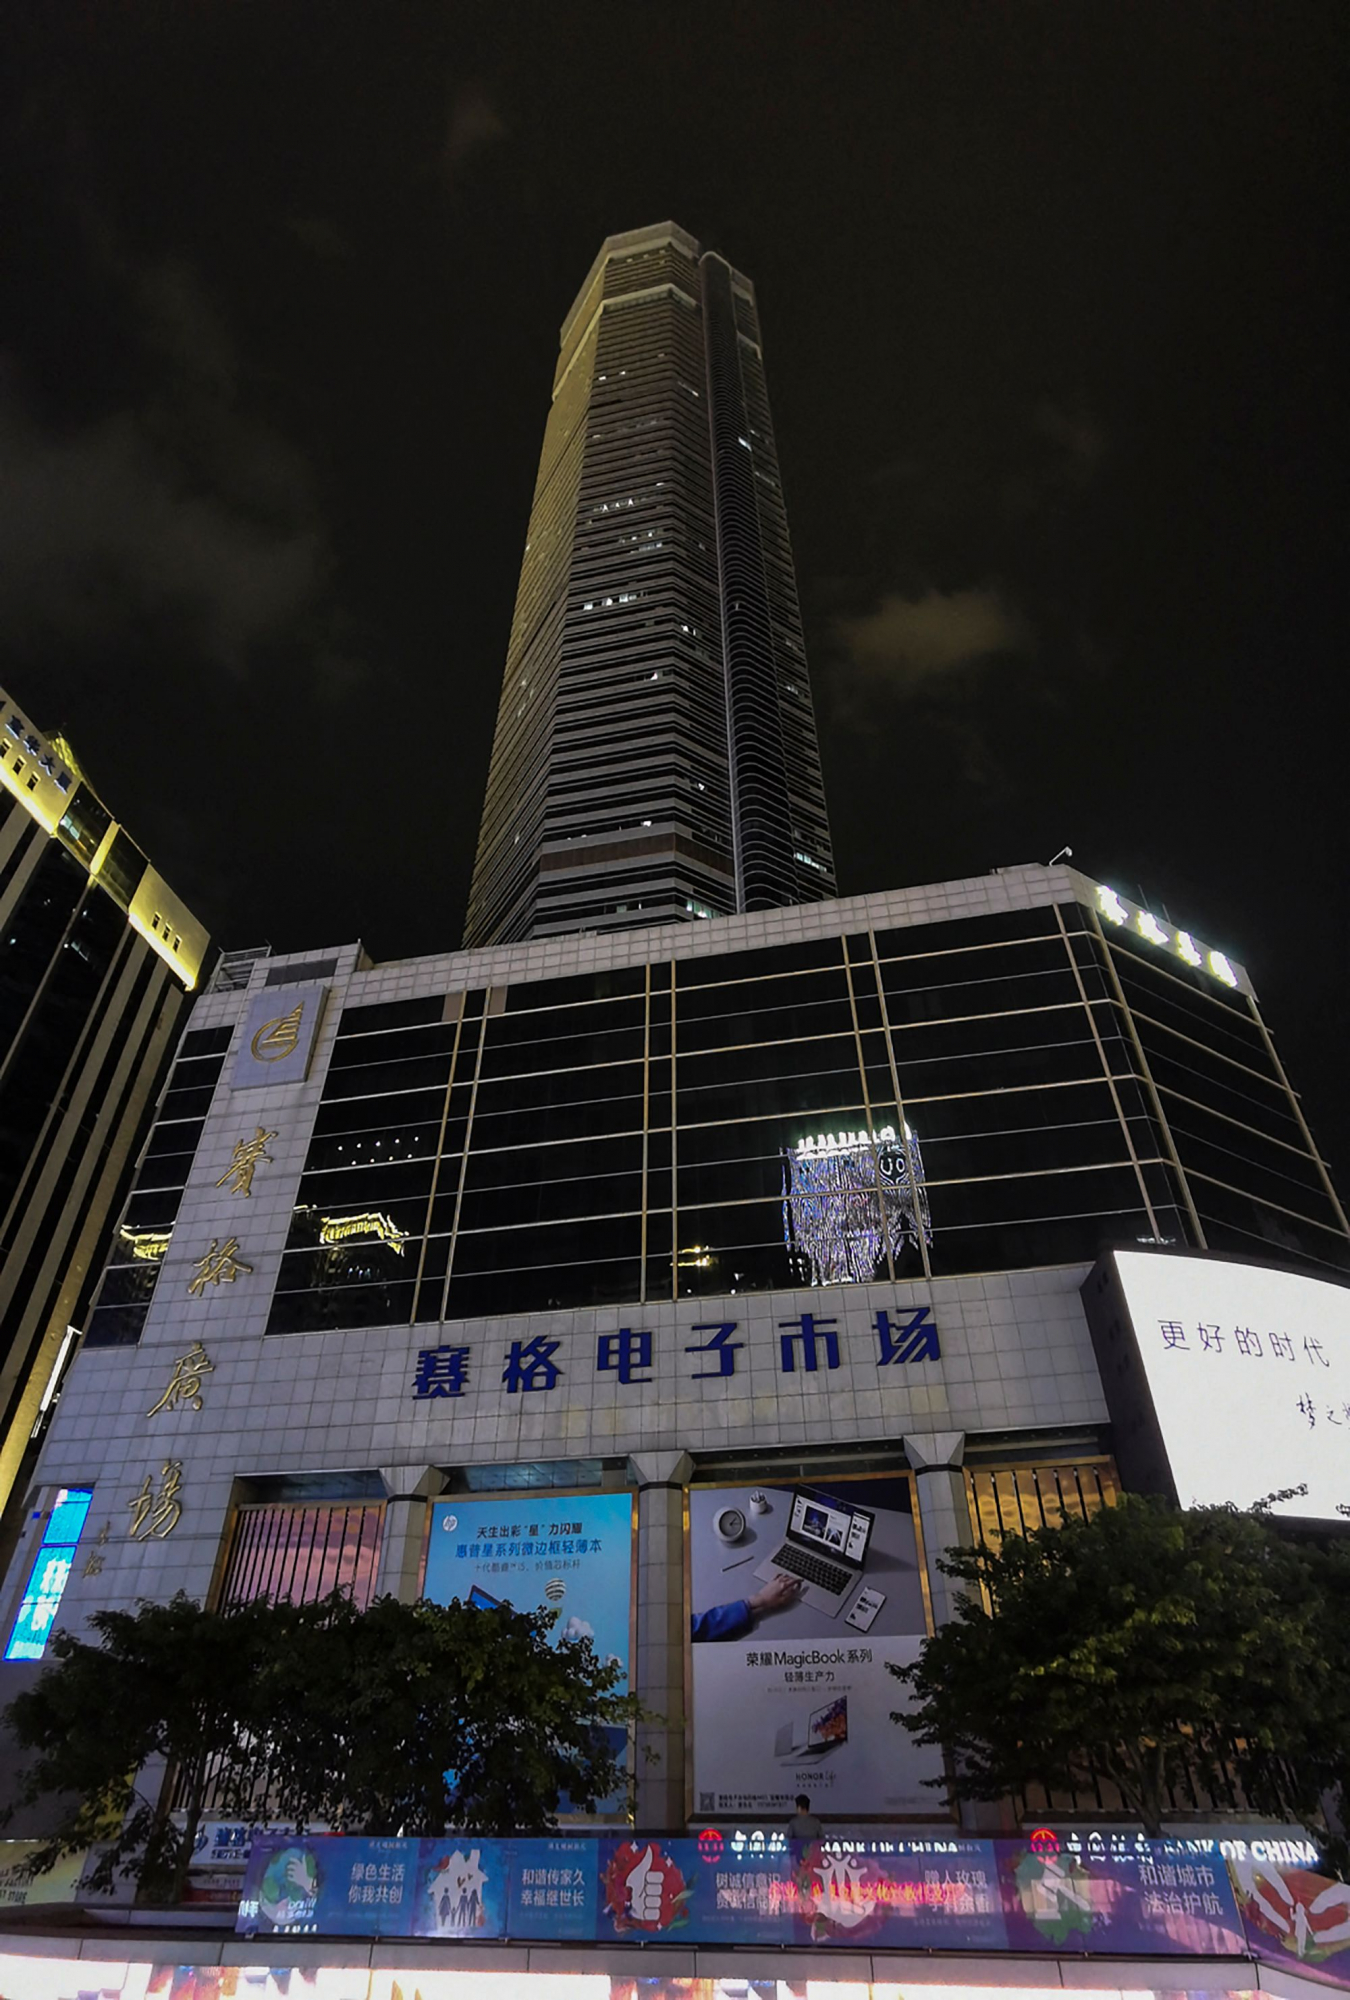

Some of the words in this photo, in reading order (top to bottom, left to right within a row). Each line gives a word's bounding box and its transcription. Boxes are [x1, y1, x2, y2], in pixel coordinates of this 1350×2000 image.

[412, 1306, 942, 1399] 赛格电子市场
[1157, 1319, 1330, 1368] 更好的时代
[784, 1671, 835, 1683] 轻薄生产力
[795, 1772, 824, 1781] HONOR
[1219, 1839, 1246, 1862] OF
[1250, 1840, 1319, 1863] CHINA
[352, 1863, 405, 1882] 绿色生活
[521, 1868, 585, 1886] 和谐传家久
[1138, 1864, 1216, 1888] 和谐城市
[348, 1885, 403, 1905] 你我共创
[521, 1889, 584, 1907] 幸福继世长
[1143, 1890, 1224, 1916] 法治护航
